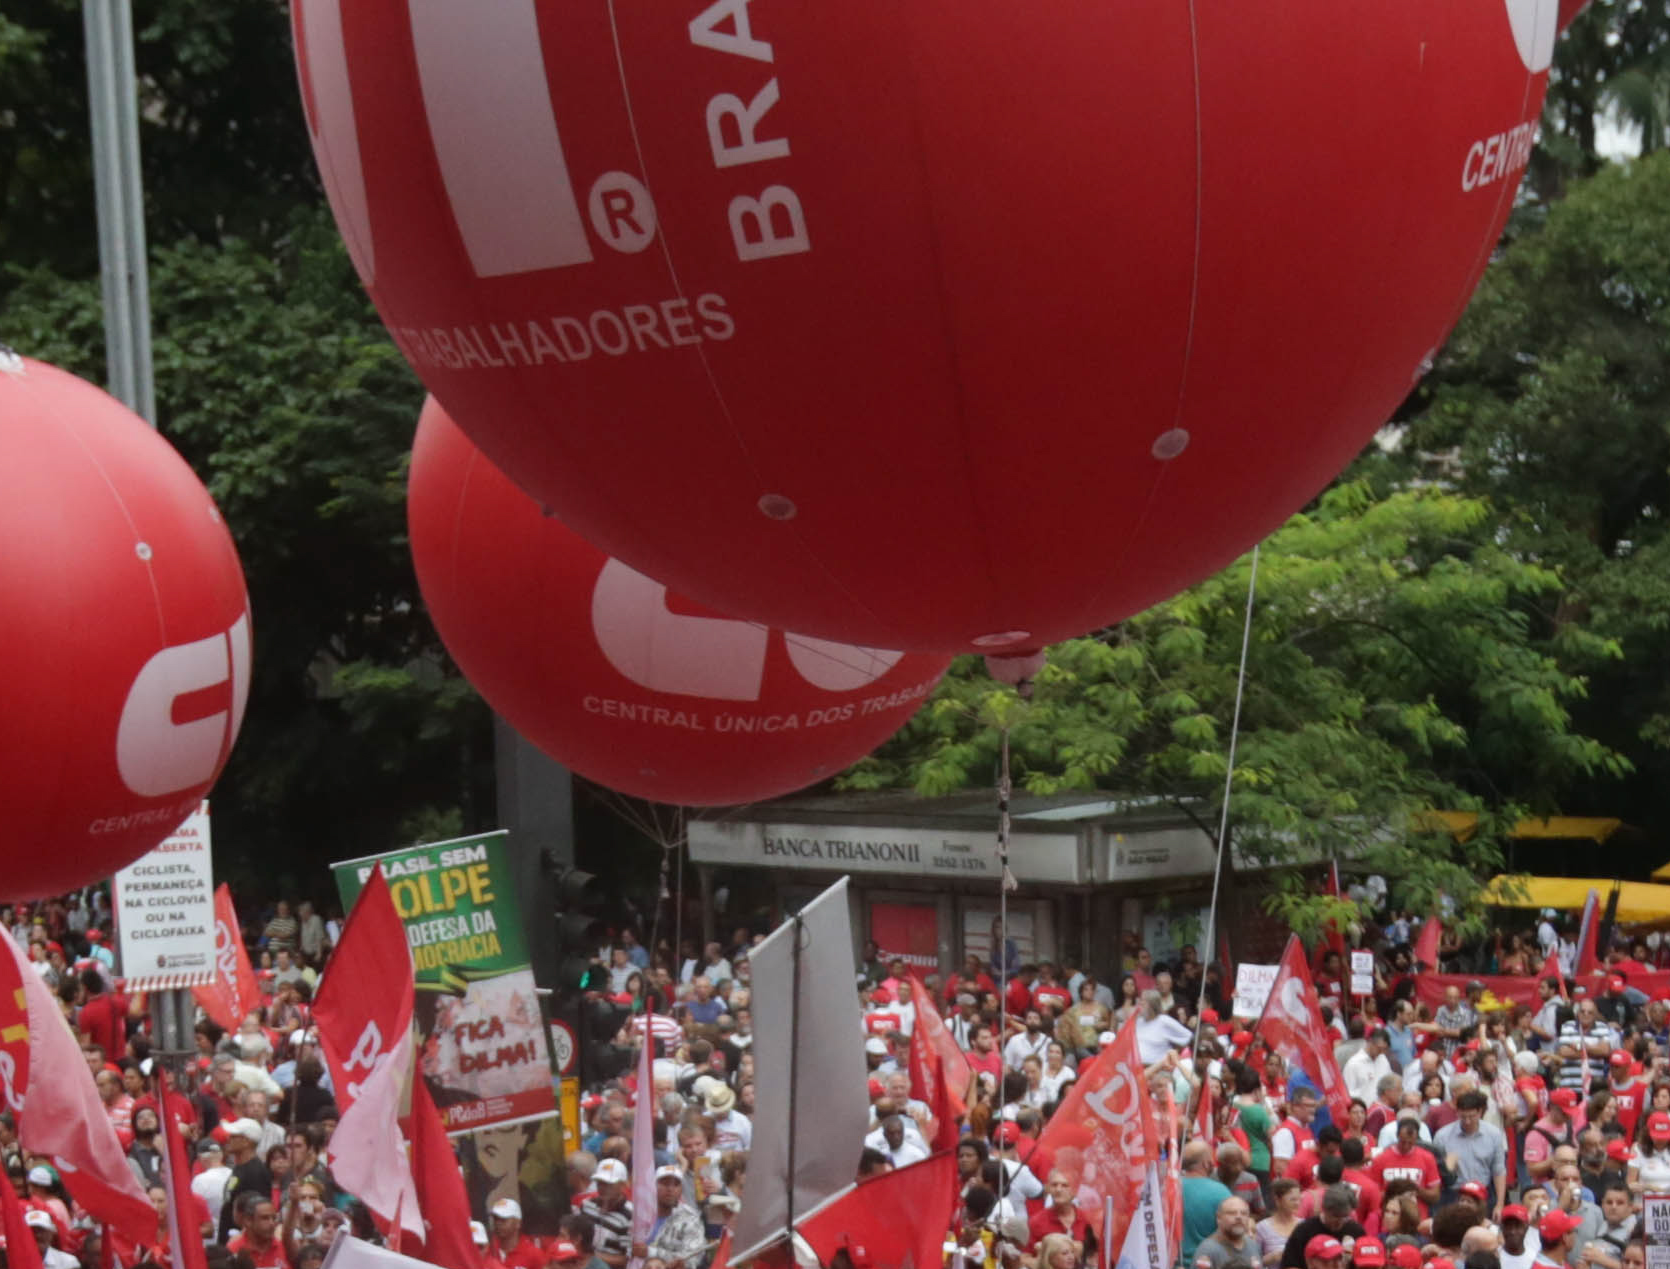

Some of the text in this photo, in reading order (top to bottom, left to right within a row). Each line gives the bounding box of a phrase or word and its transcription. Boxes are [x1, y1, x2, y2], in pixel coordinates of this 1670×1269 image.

[583, 694, 856, 734] CENTRAL ÚNICA DOS
[439, 844, 487, 868] SEM
[762, 836, 828, 858] BANCA
[124, 895, 207, 909] NA CICLOVIA
[388, 862, 495, 918] OLPE
[131, 926, 206, 940] CICLOFAIXA
[468, 910, 497, 936] DA
[413, 932, 501, 969] MOCRACIA
[454, 1015, 506, 1044] FICA
[458, 1041, 536, 1073] DILMA!
